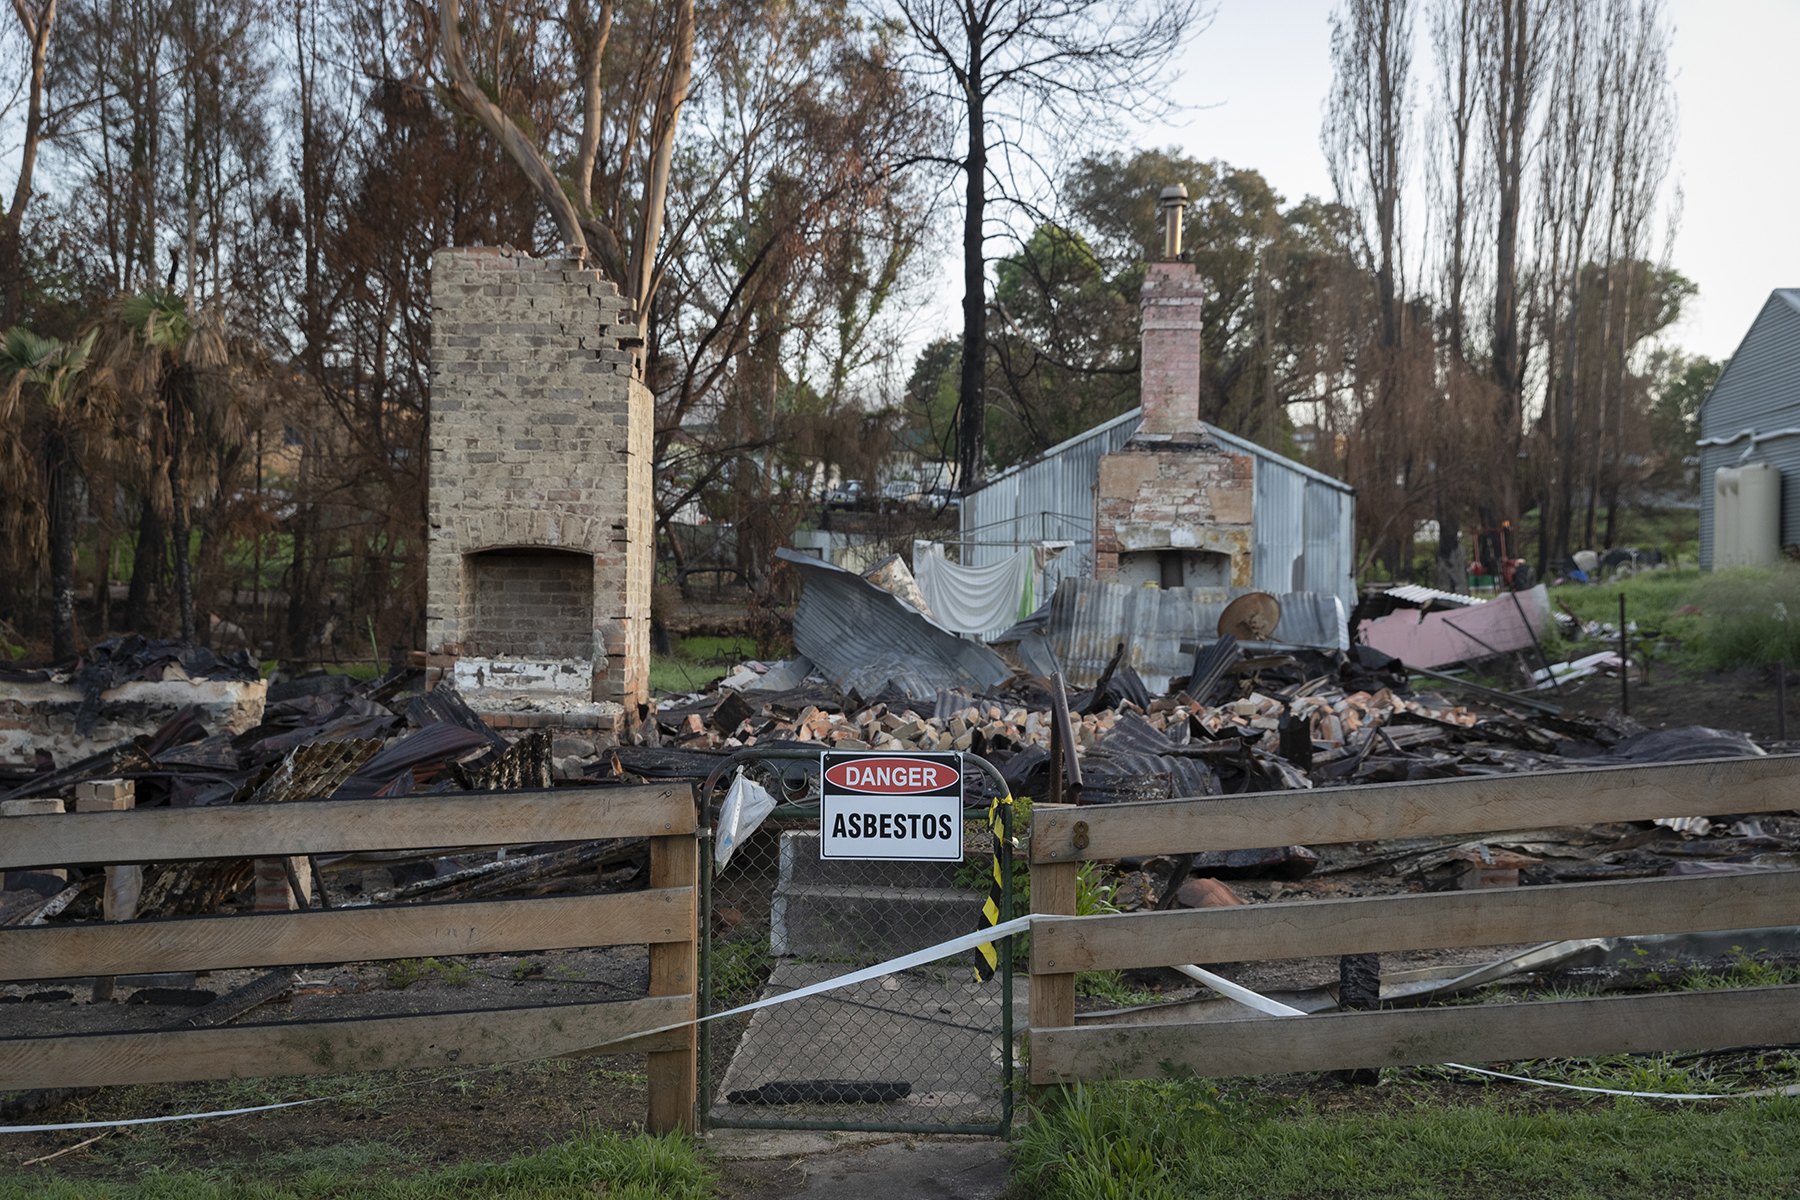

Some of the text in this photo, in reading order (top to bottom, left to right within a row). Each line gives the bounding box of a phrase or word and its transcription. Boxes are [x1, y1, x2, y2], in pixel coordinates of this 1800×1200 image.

[845, 766, 938, 787] DANGER
[832, 813, 952, 840] ASBESTOS
[1072, 820, 1090, 849] 8
